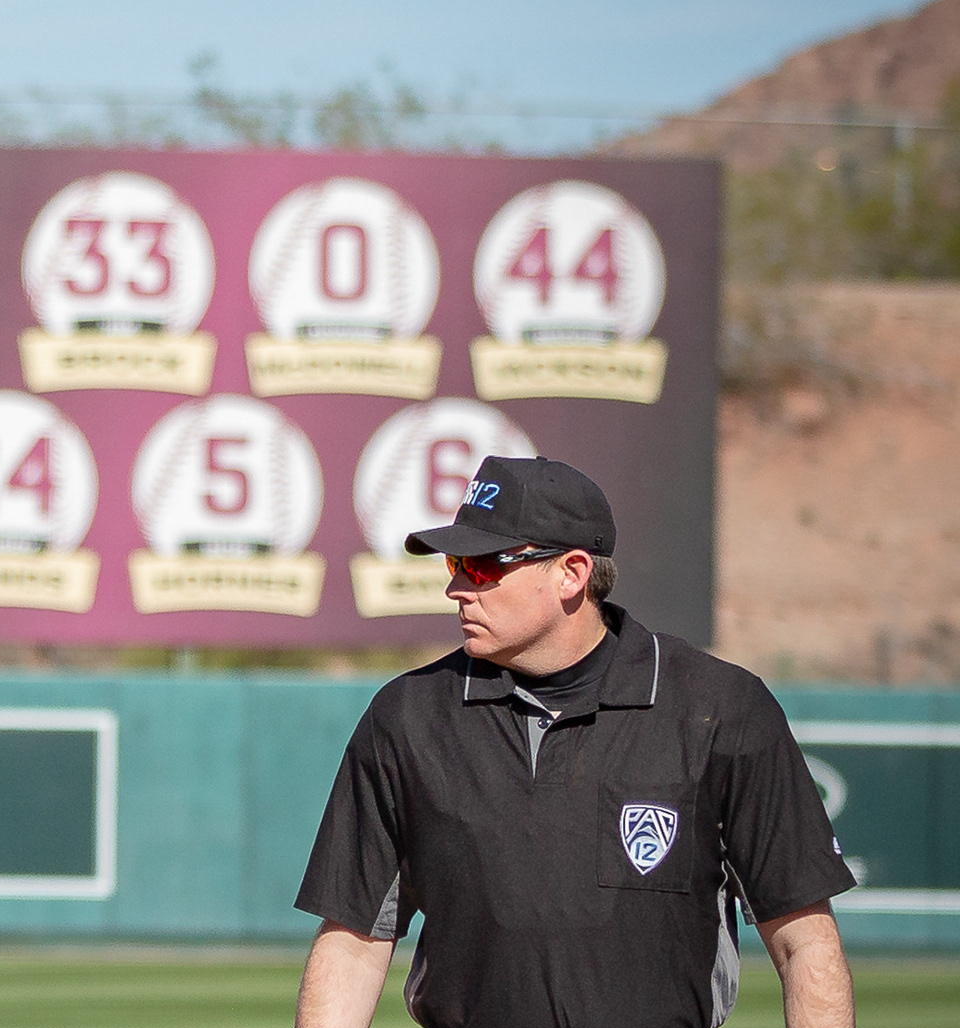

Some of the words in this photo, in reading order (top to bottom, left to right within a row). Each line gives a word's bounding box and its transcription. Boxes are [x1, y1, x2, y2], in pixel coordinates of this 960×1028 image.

[63, 217, 173, 298] 33
[320, 223, 369, 301] 0
[503, 225, 620, 305] 44
[203, 437, 251, 516] 5
[427, 438, 472, 515] 6
[625, 808, 674, 849] PAC
[634, 841, 658, 862] 12
